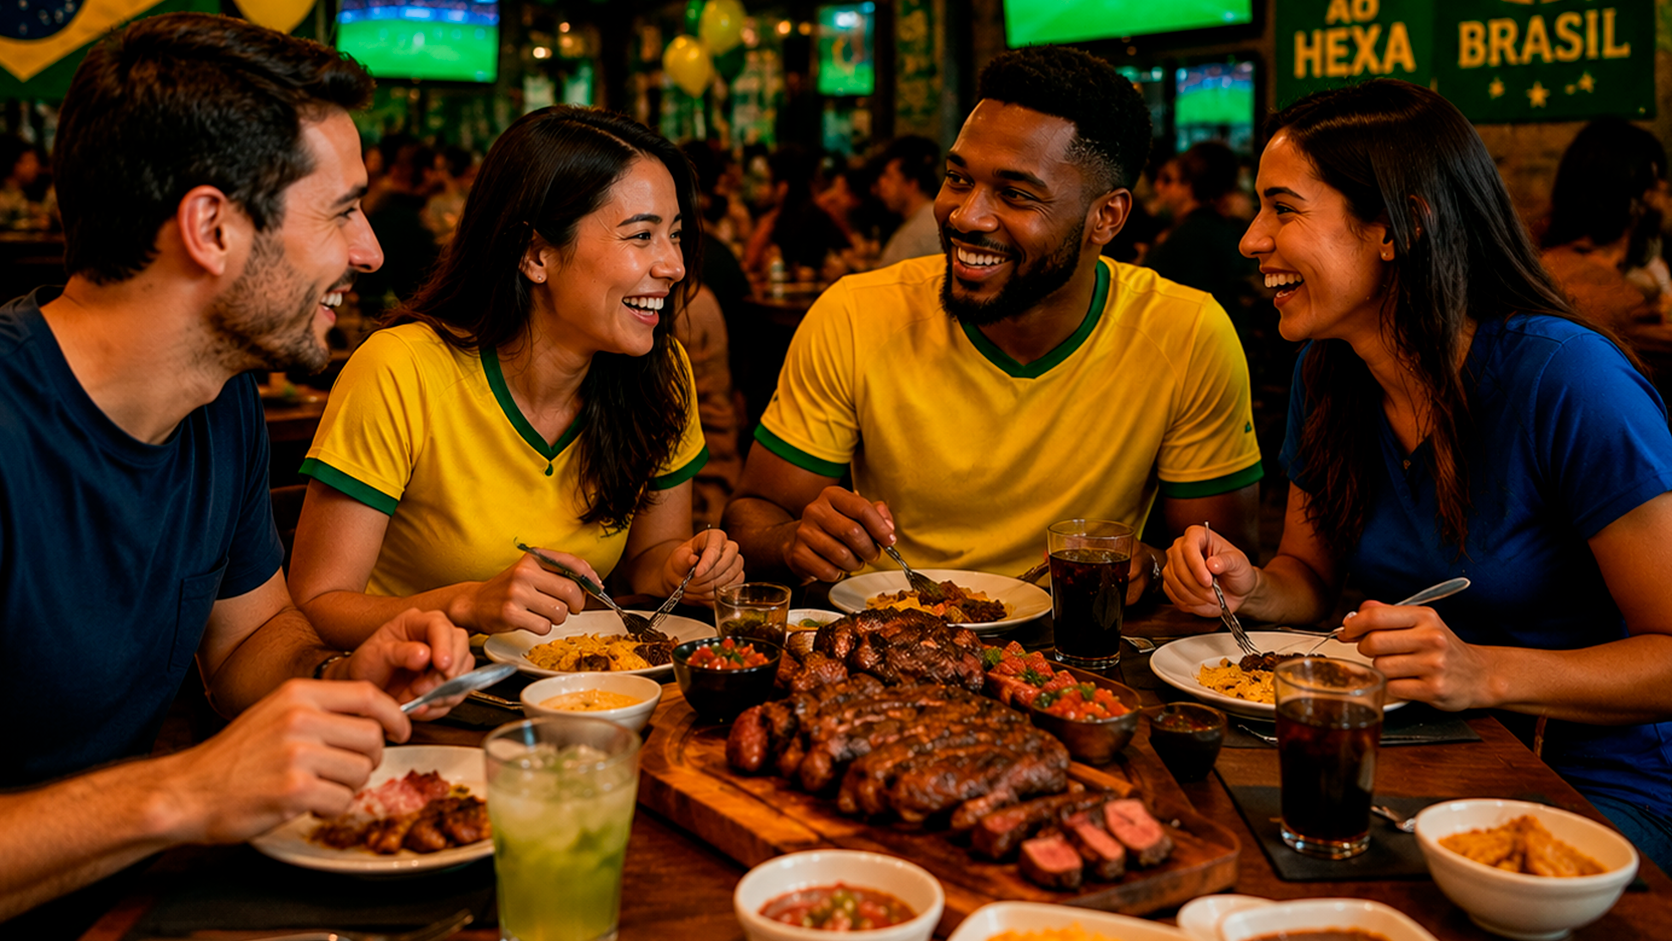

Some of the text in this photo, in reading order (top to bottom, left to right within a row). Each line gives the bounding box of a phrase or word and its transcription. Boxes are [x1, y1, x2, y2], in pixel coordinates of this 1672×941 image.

[1325, 0, 1379, 25] AO
[1458, 8, 1631, 68] BRASIL
[1294, 22, 1416, 78] HEXA
